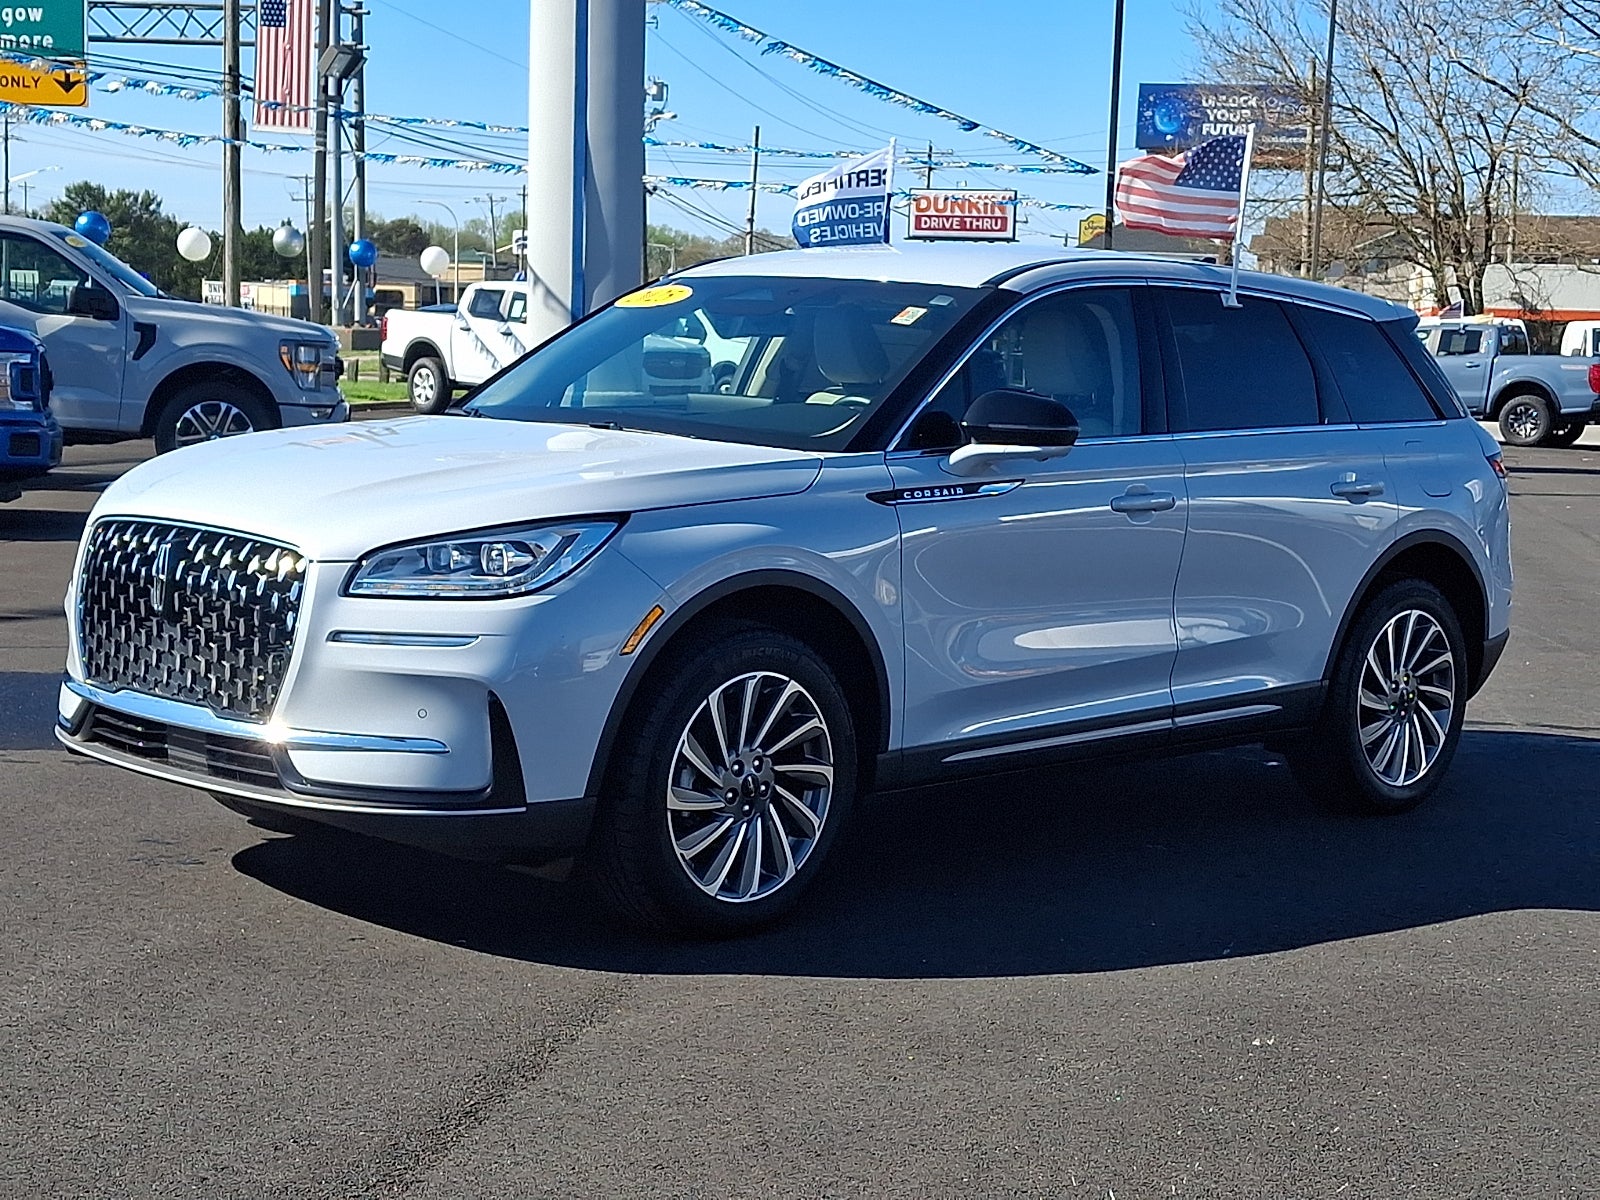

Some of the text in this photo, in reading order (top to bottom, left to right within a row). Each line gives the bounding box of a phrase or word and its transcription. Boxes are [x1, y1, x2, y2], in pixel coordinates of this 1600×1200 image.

[0, 75, 41, 89] ONLY
[1206, 109, 1252, 122] YOUR
[1201, 123, 1247, 136] FUTUR
[920, 217, 1001, 231] DRIVE THRU
[903, 487, 964, 499] CORSAIR
